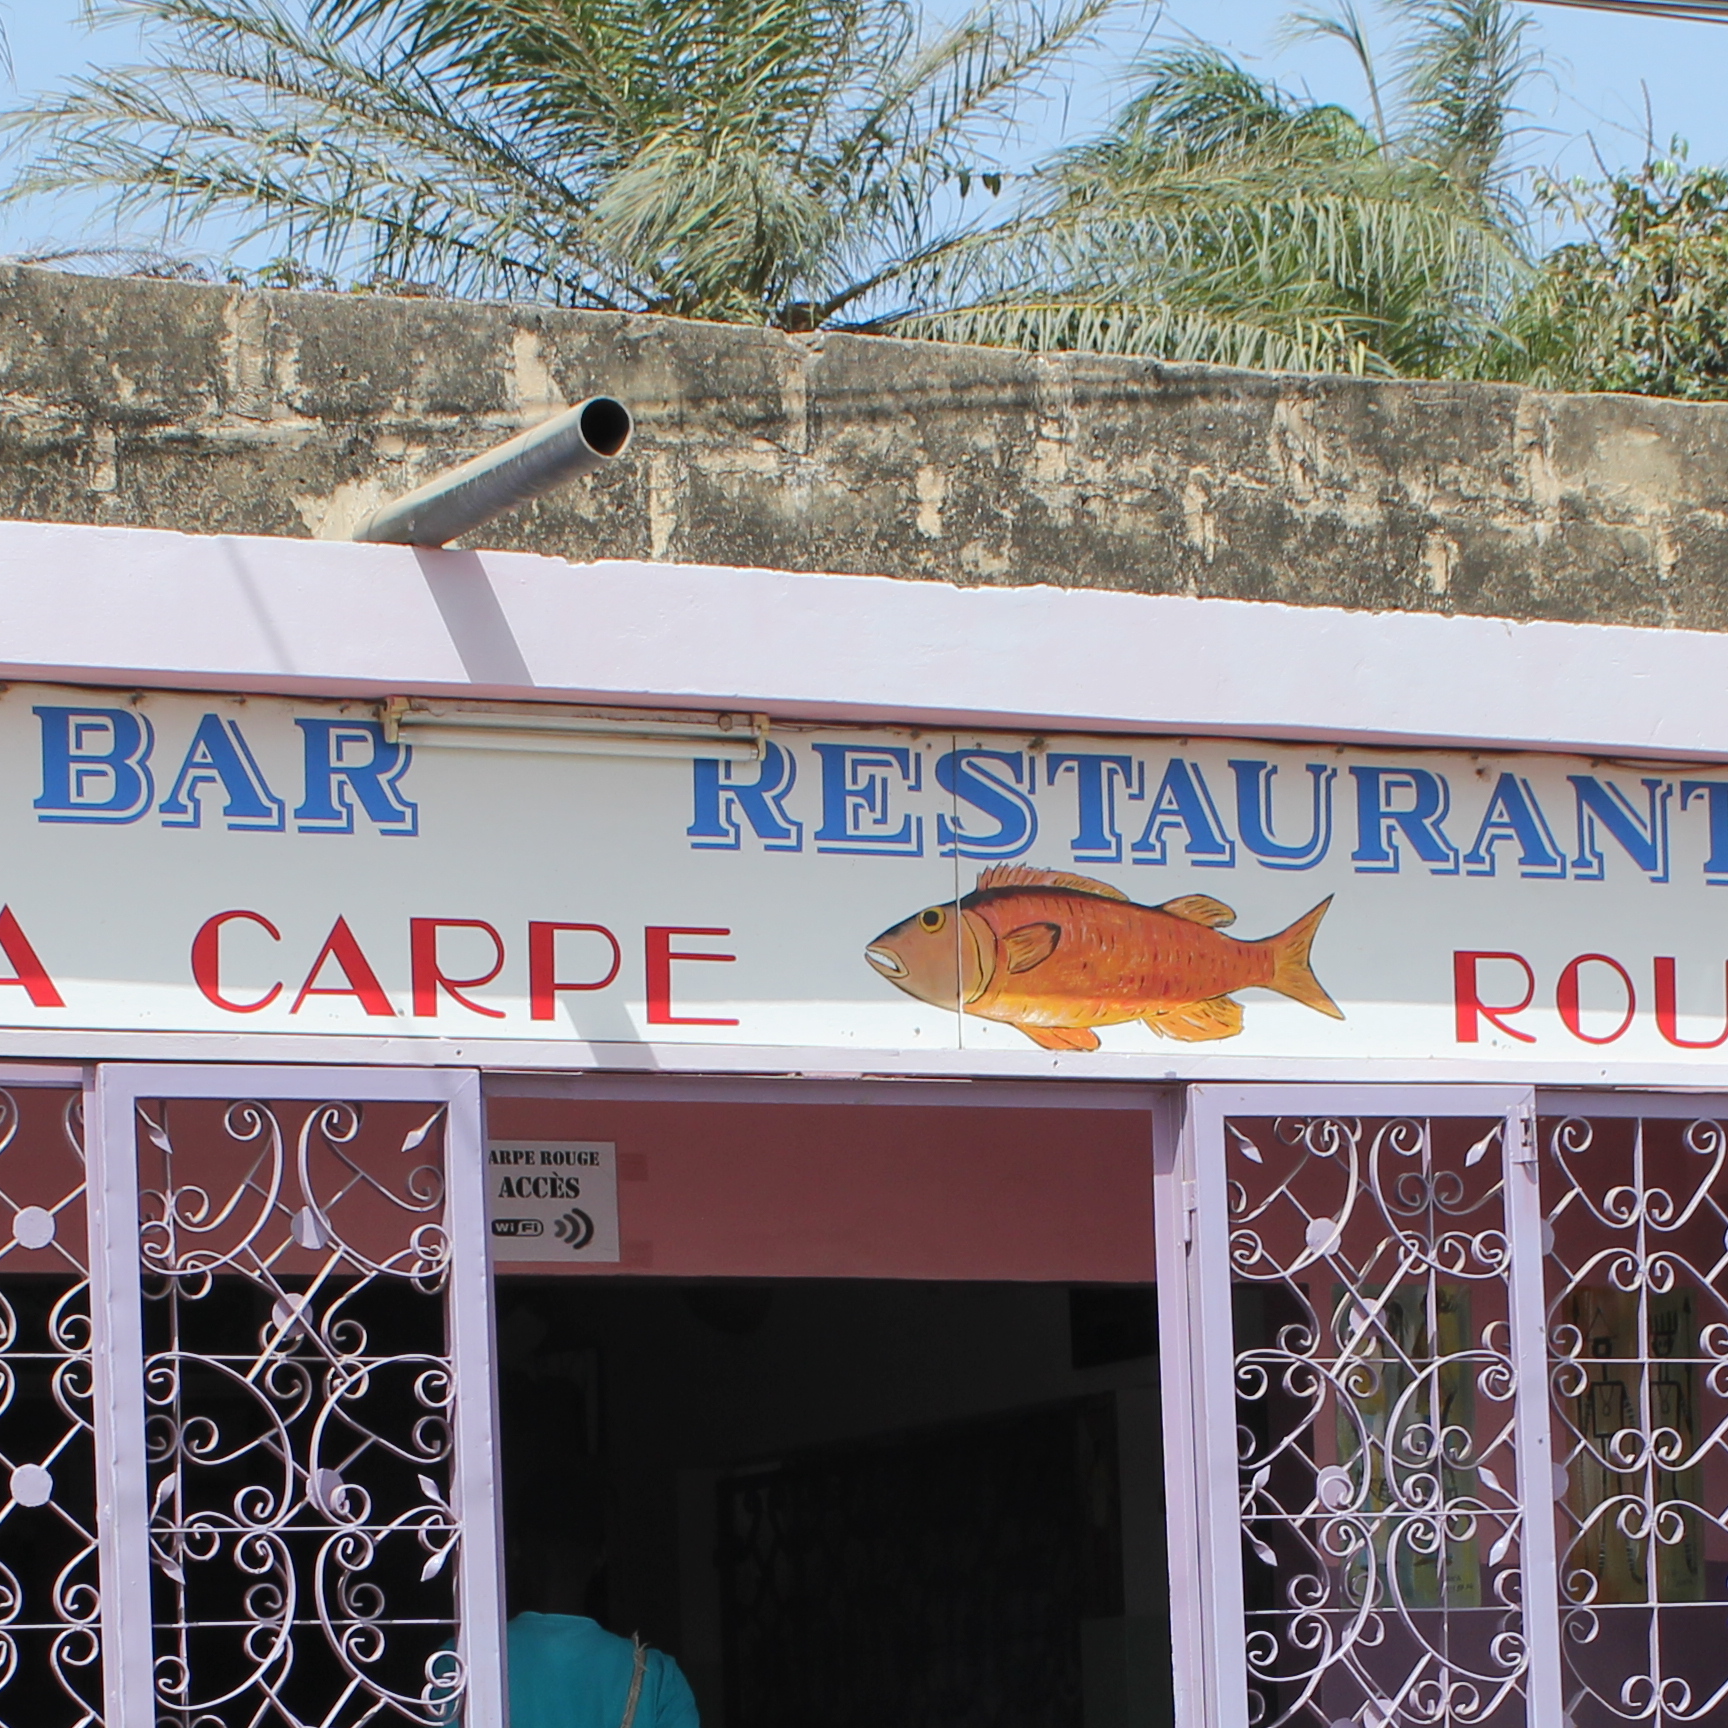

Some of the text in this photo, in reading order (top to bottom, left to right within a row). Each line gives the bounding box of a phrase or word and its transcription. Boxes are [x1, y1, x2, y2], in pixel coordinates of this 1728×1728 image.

[32, 705, 420, 837] BAR
[189, 908, 741, 1026] CARPE
[488, 1149, 600, 1167] ARPE ROUGE
[498, 1171, 581, 1199] ACCÈS
